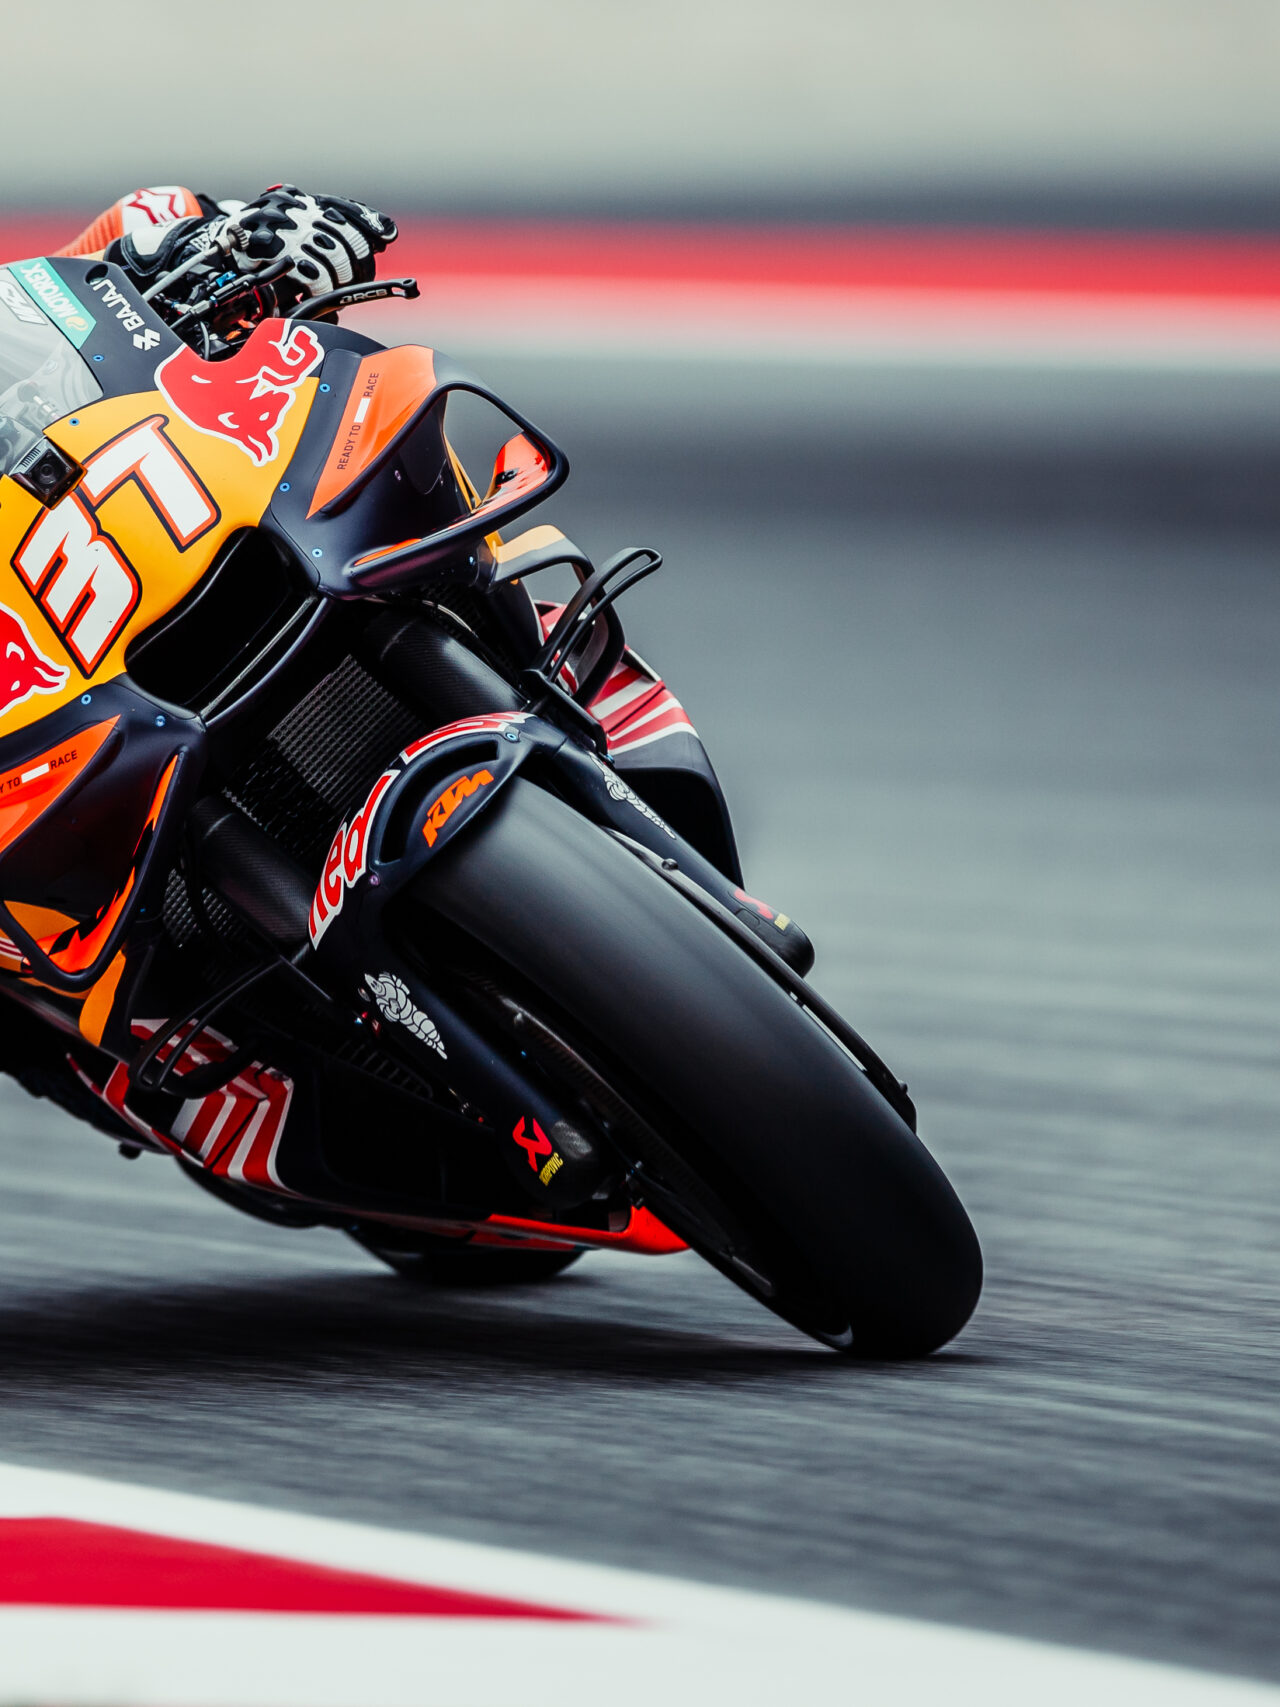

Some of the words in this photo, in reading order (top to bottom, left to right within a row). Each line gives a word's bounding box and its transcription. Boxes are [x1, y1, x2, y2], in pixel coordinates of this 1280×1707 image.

[21, 263, 79, 318] MOTOREX
[92, 278, 145, 332] BAJAJ
[352, 288, 388, 302] RCB
[337, 439, 356, 470] READY
[348, 424, 361, 436] TO
[363, 372, 380, 398] RACE
[10, 414, 222, 680] 37
[7, 776, 21, 790] TO
[50, 750, 78, 770] RACE
[422, 769, 494, 848] KTM
